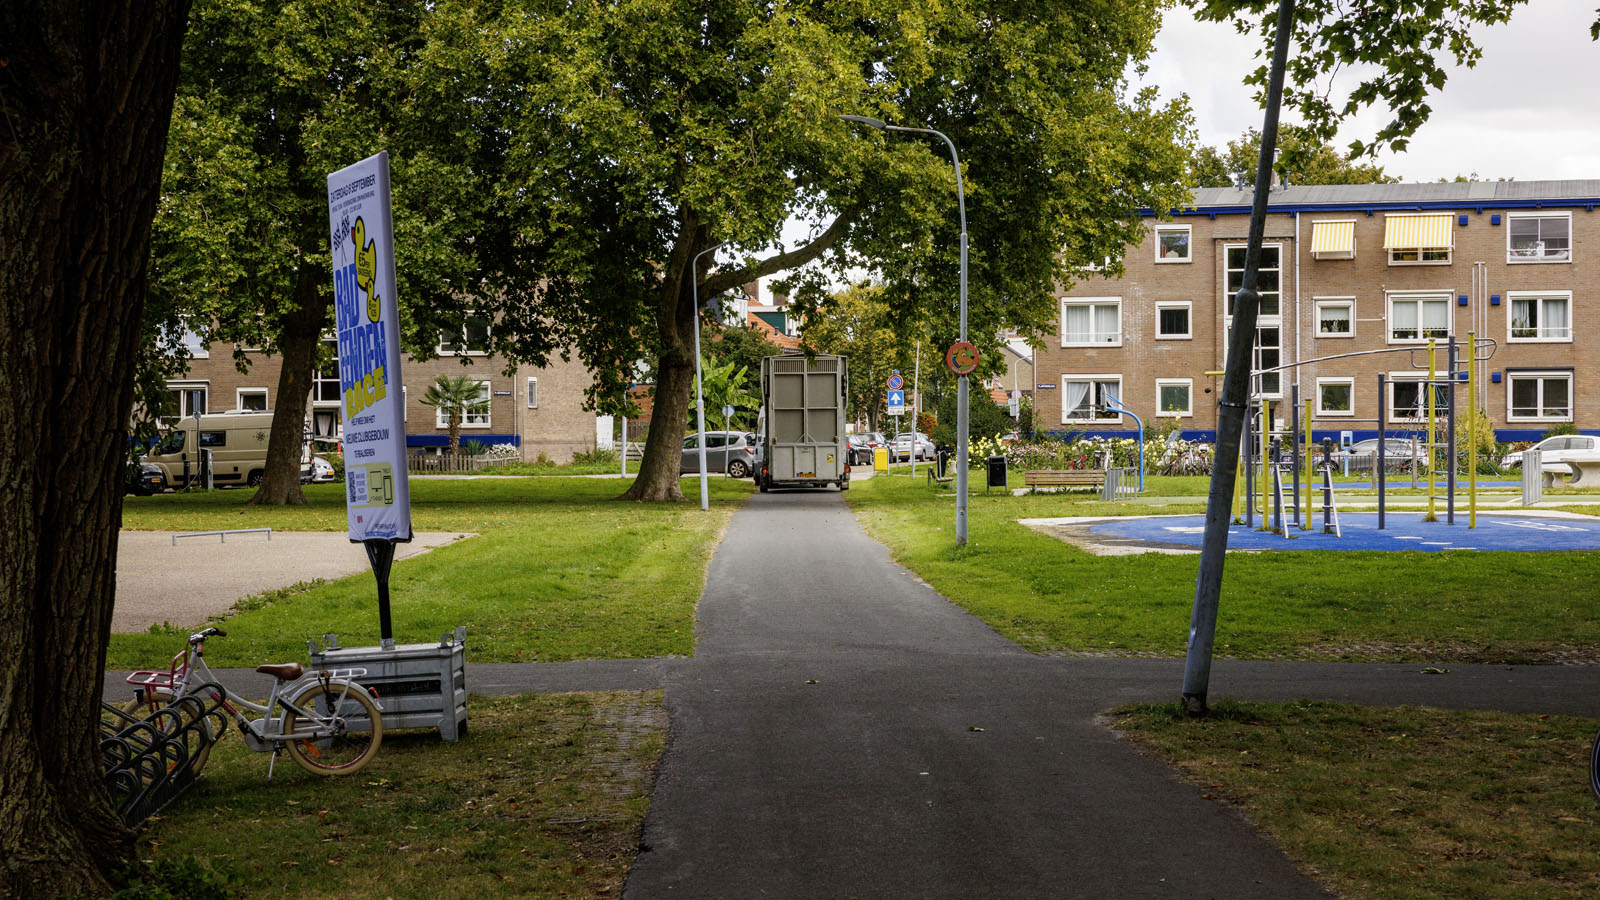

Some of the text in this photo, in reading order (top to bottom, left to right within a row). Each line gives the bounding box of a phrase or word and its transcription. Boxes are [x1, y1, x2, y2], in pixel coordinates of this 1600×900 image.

[335, 263, 360, 332] BAD
[339, 321, 388, 393] EENDEN
[345, 365, 387, 420] RACE
[357, 428, 390, 442] CLUBGEBOUW
